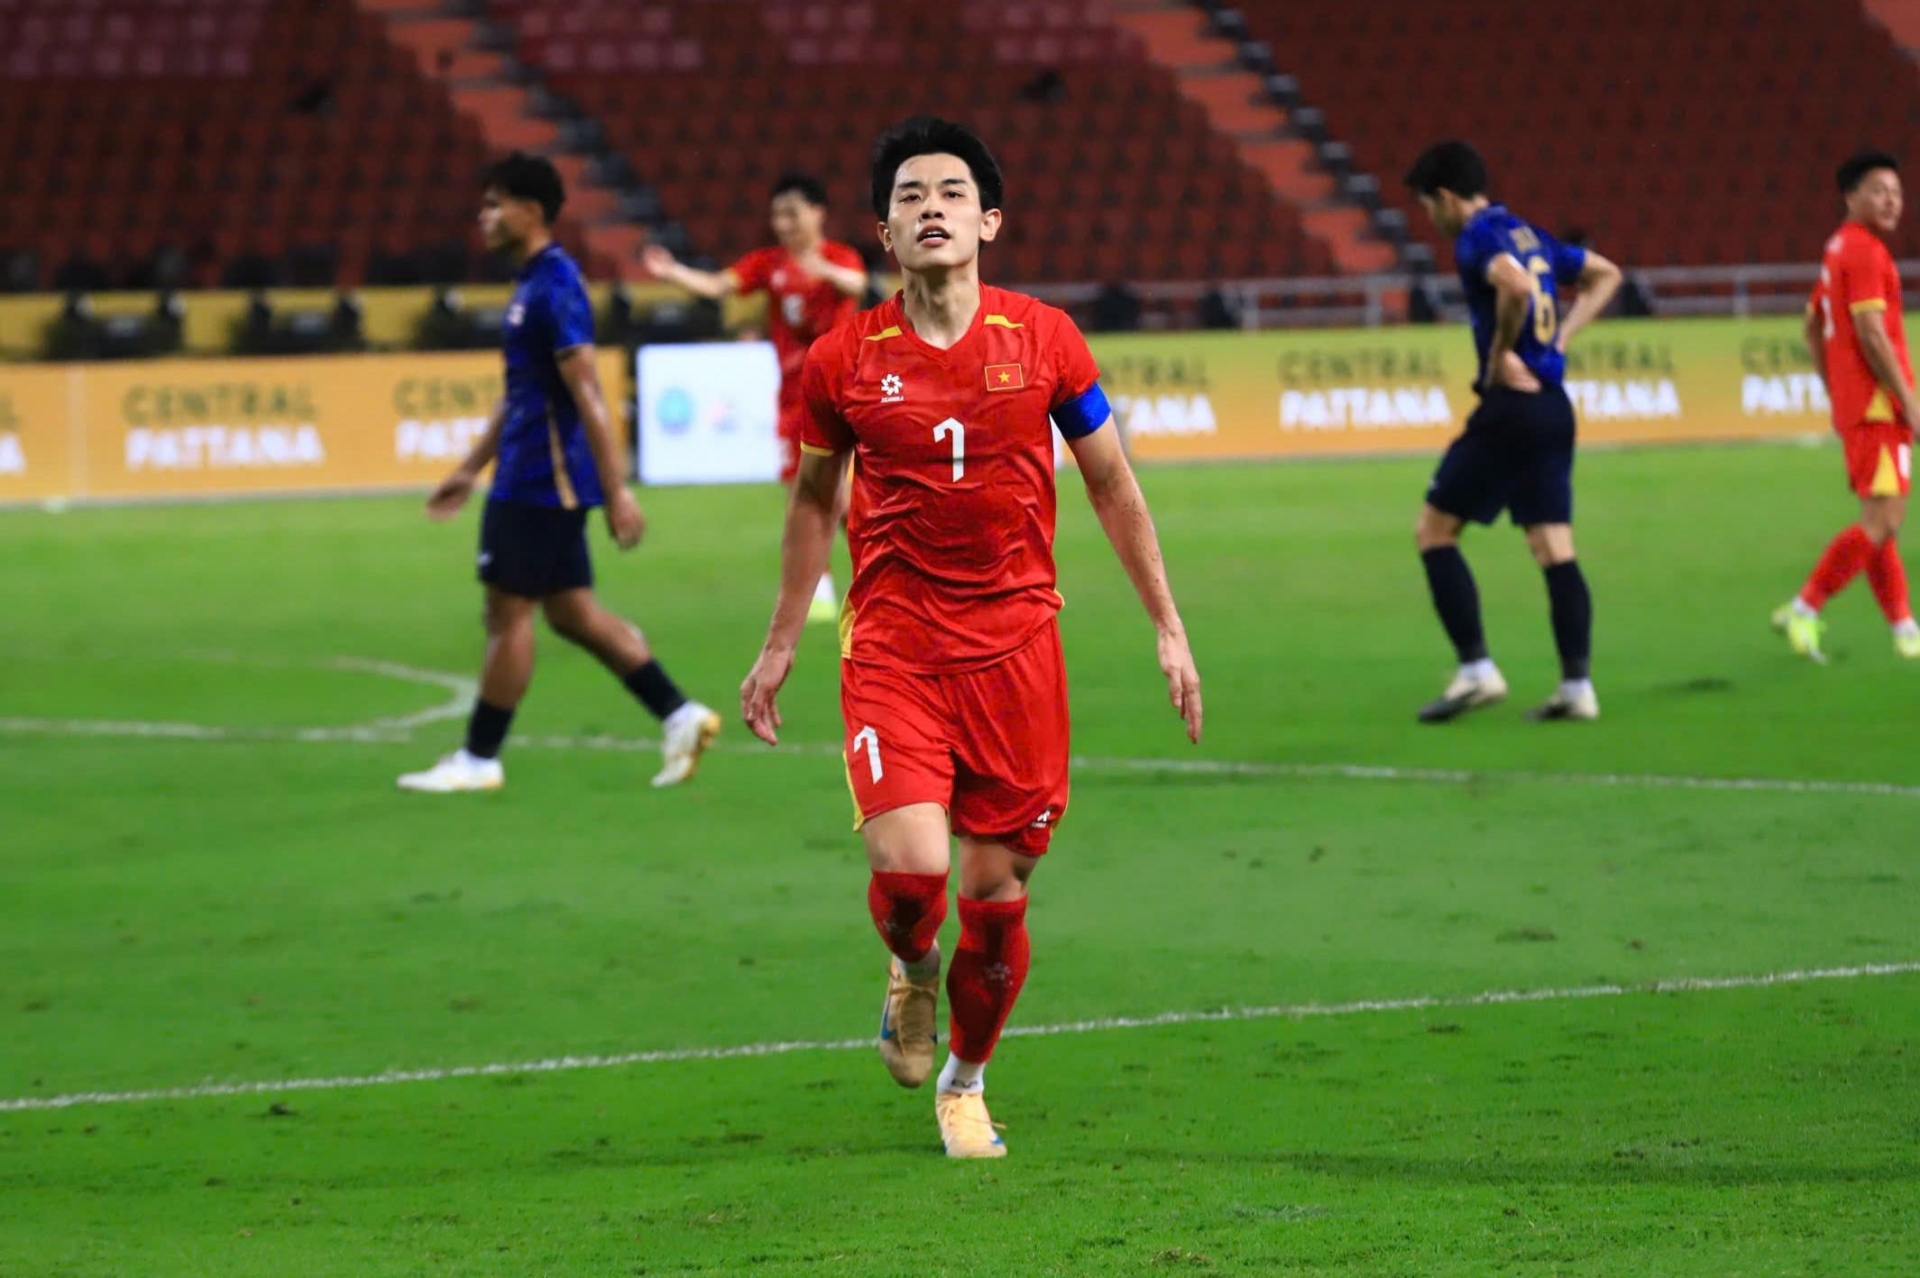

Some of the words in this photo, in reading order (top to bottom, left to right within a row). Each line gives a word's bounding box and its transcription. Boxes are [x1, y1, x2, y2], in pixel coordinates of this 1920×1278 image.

[1528, 255, 1557, 344] 6
[1278, 347, 1447, 387] CENTRAL
[122, 382, 318, 426] CENTRAL
[393, 376, 502, 418] CENT
[1279, 385, 1453, 430] PATTANA
[1742, 373, 1829, 415] PATT
[124, 424, 326, 472] PATTANA
[395, 418, 490, 458] PATT
[933, 417, 965, 483] 7
[854, 725, 883, 785] 7
